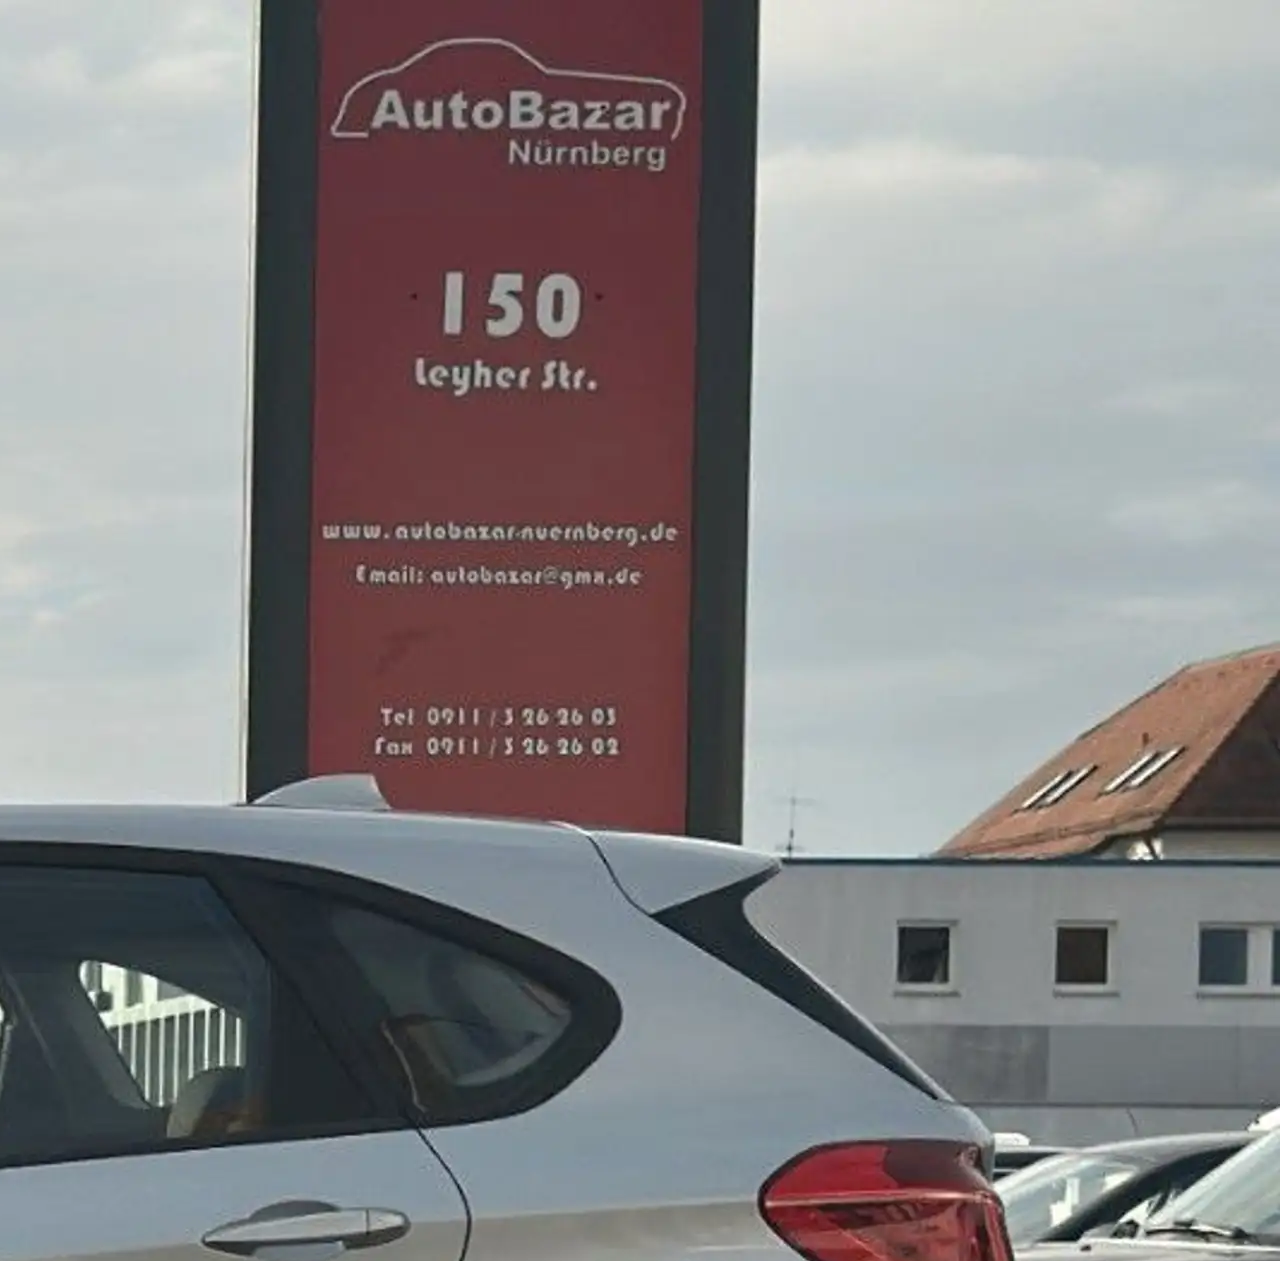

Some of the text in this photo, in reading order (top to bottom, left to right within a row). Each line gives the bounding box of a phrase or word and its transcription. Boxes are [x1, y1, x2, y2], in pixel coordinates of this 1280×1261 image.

[371, 89, 671, 131] AutoBazar
[508, 139, 666, 172] Nürnberg
[443, 271, 581, 338] 150
[415, 357, 597, 397] Leyher Str.
[430, 565, 642, 590] autobazar@gmx.de
[380, 707, 414, 726] Tel
[375, 736, 413, 755] Fax
